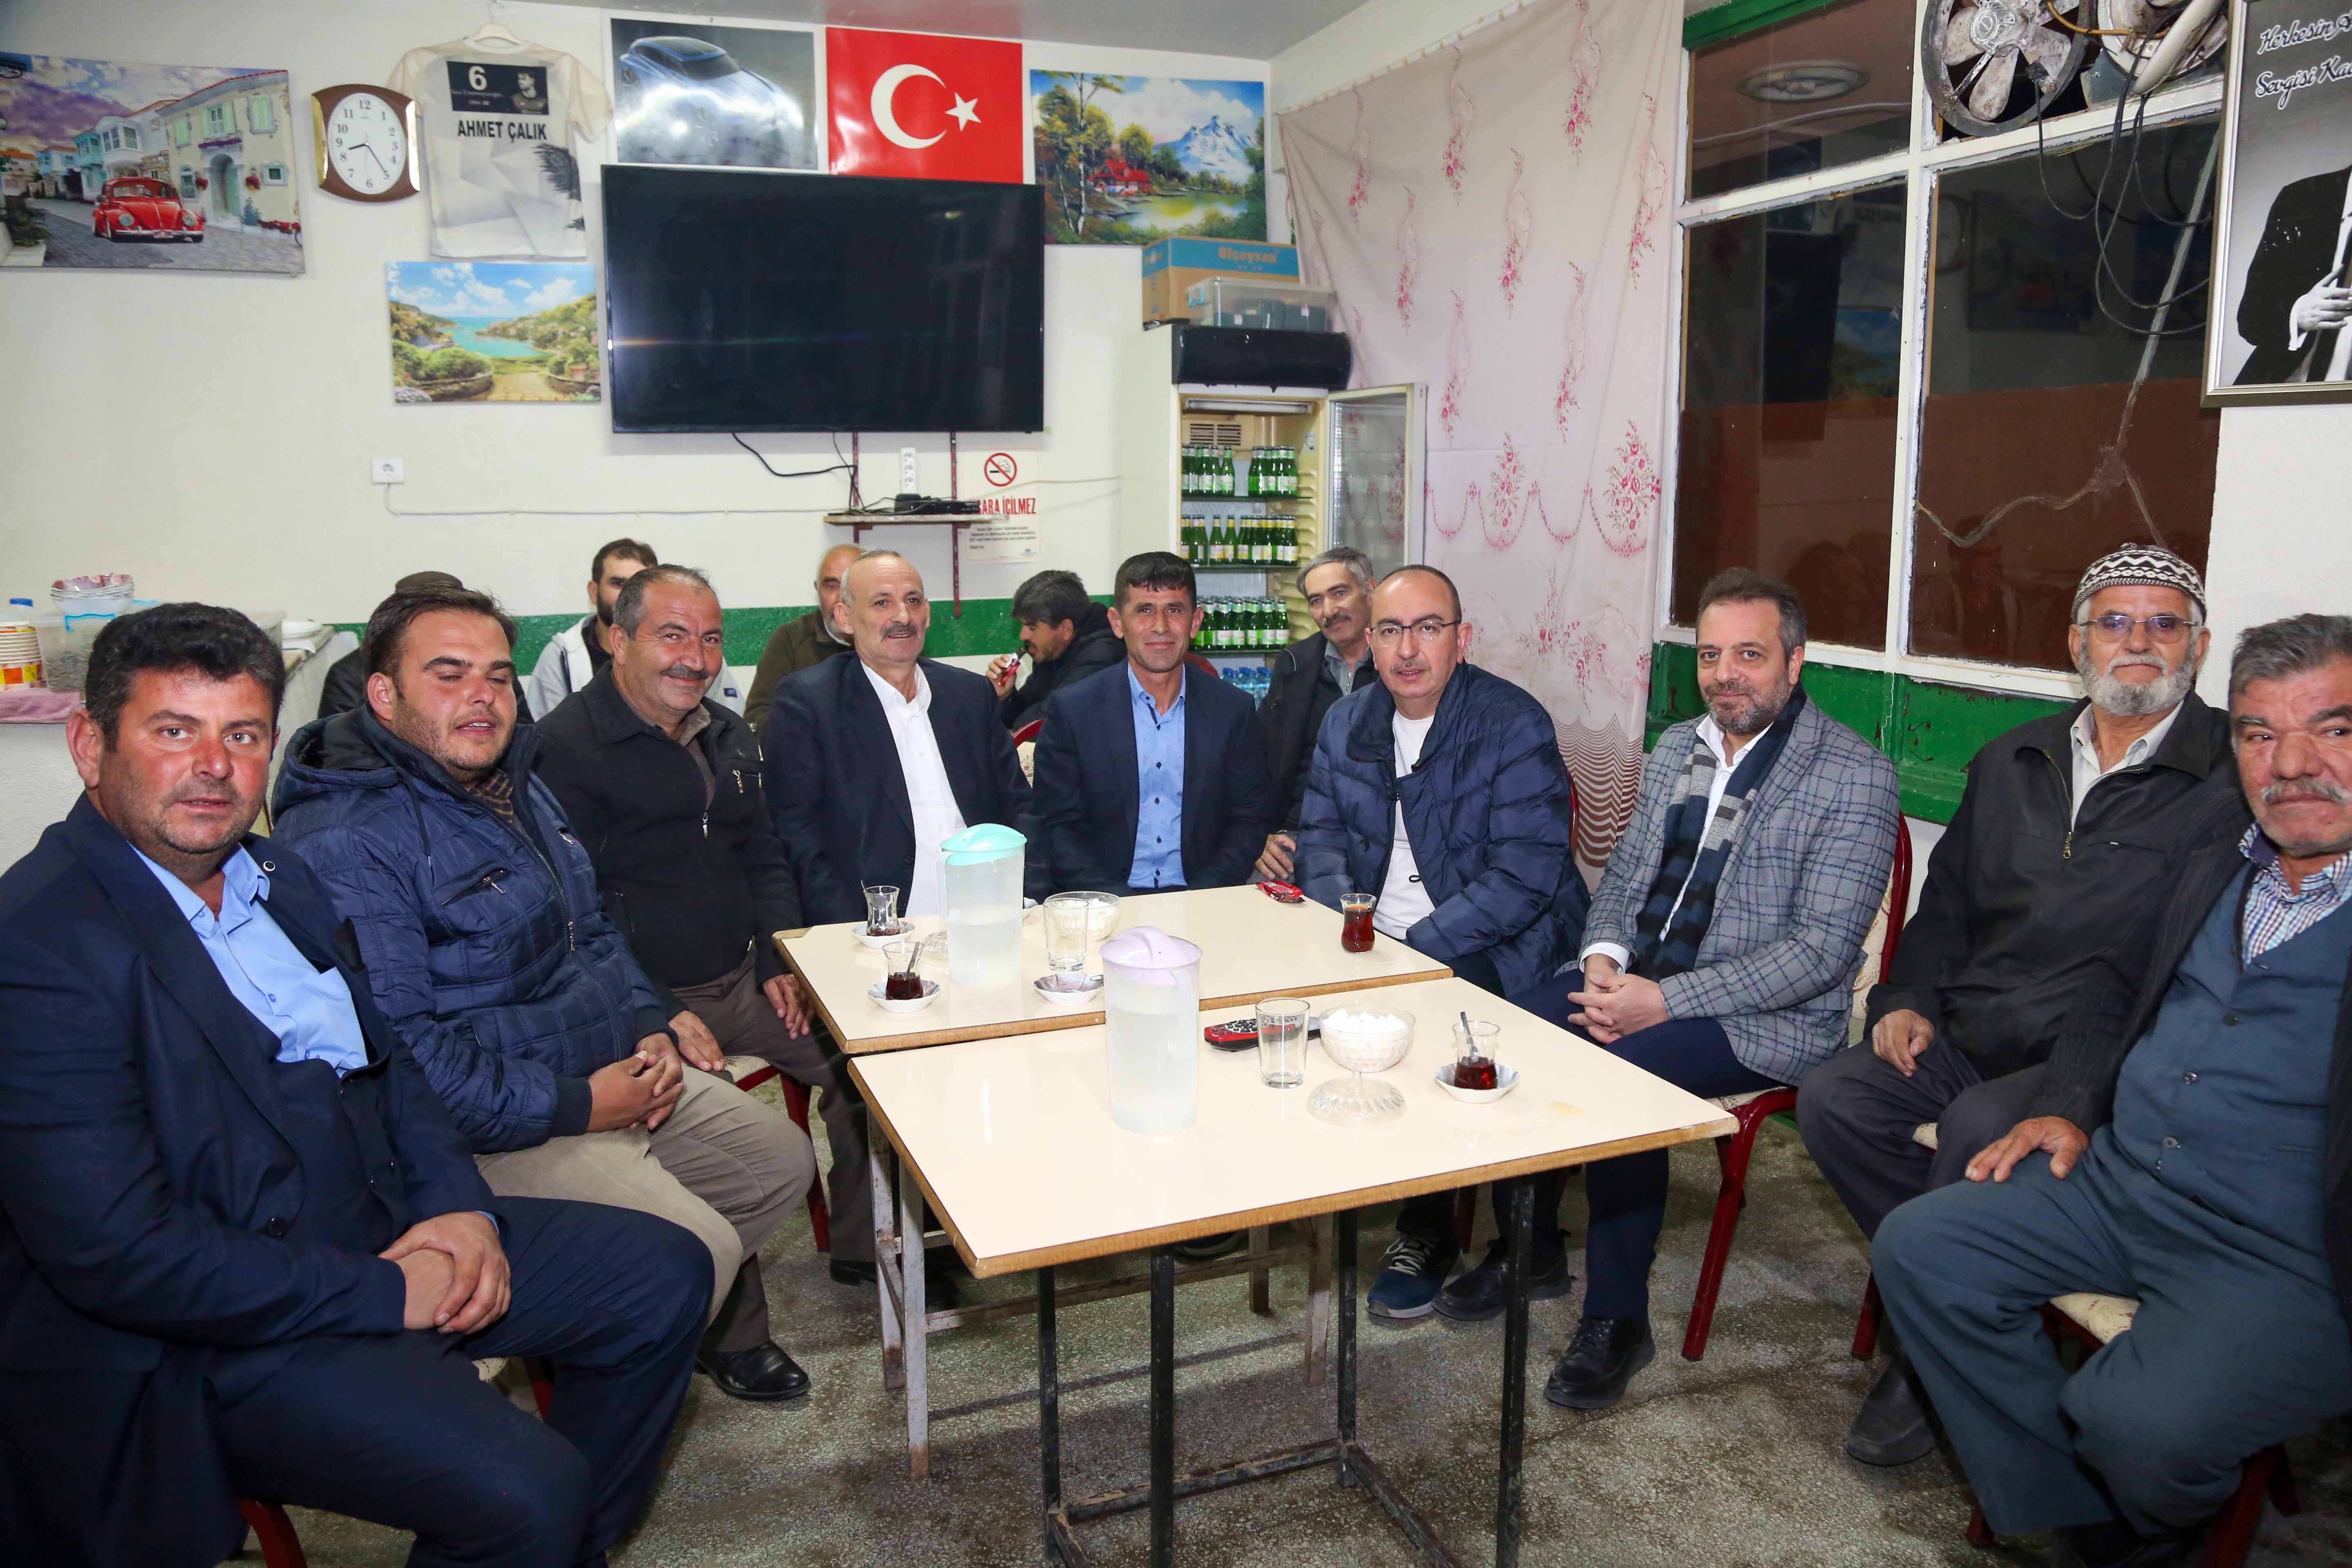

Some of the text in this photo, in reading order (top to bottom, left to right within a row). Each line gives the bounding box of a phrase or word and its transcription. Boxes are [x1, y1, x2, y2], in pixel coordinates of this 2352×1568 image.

[468, 65, 488, 91] 6
[2255, 67, 2318, 110] Sevgisi
[359, 100, 371, 110] 12
[344, 109, 354, 119] 11
[382, 111, 386, 121] 1
[336, 124, 348, 134] 10
[458, 119, 547, 143] AHMET ÇALIK
[336, 138, 343, 147] 9
[340, 152, 347, 162] 8
[366, 178, 373, 188] 6
